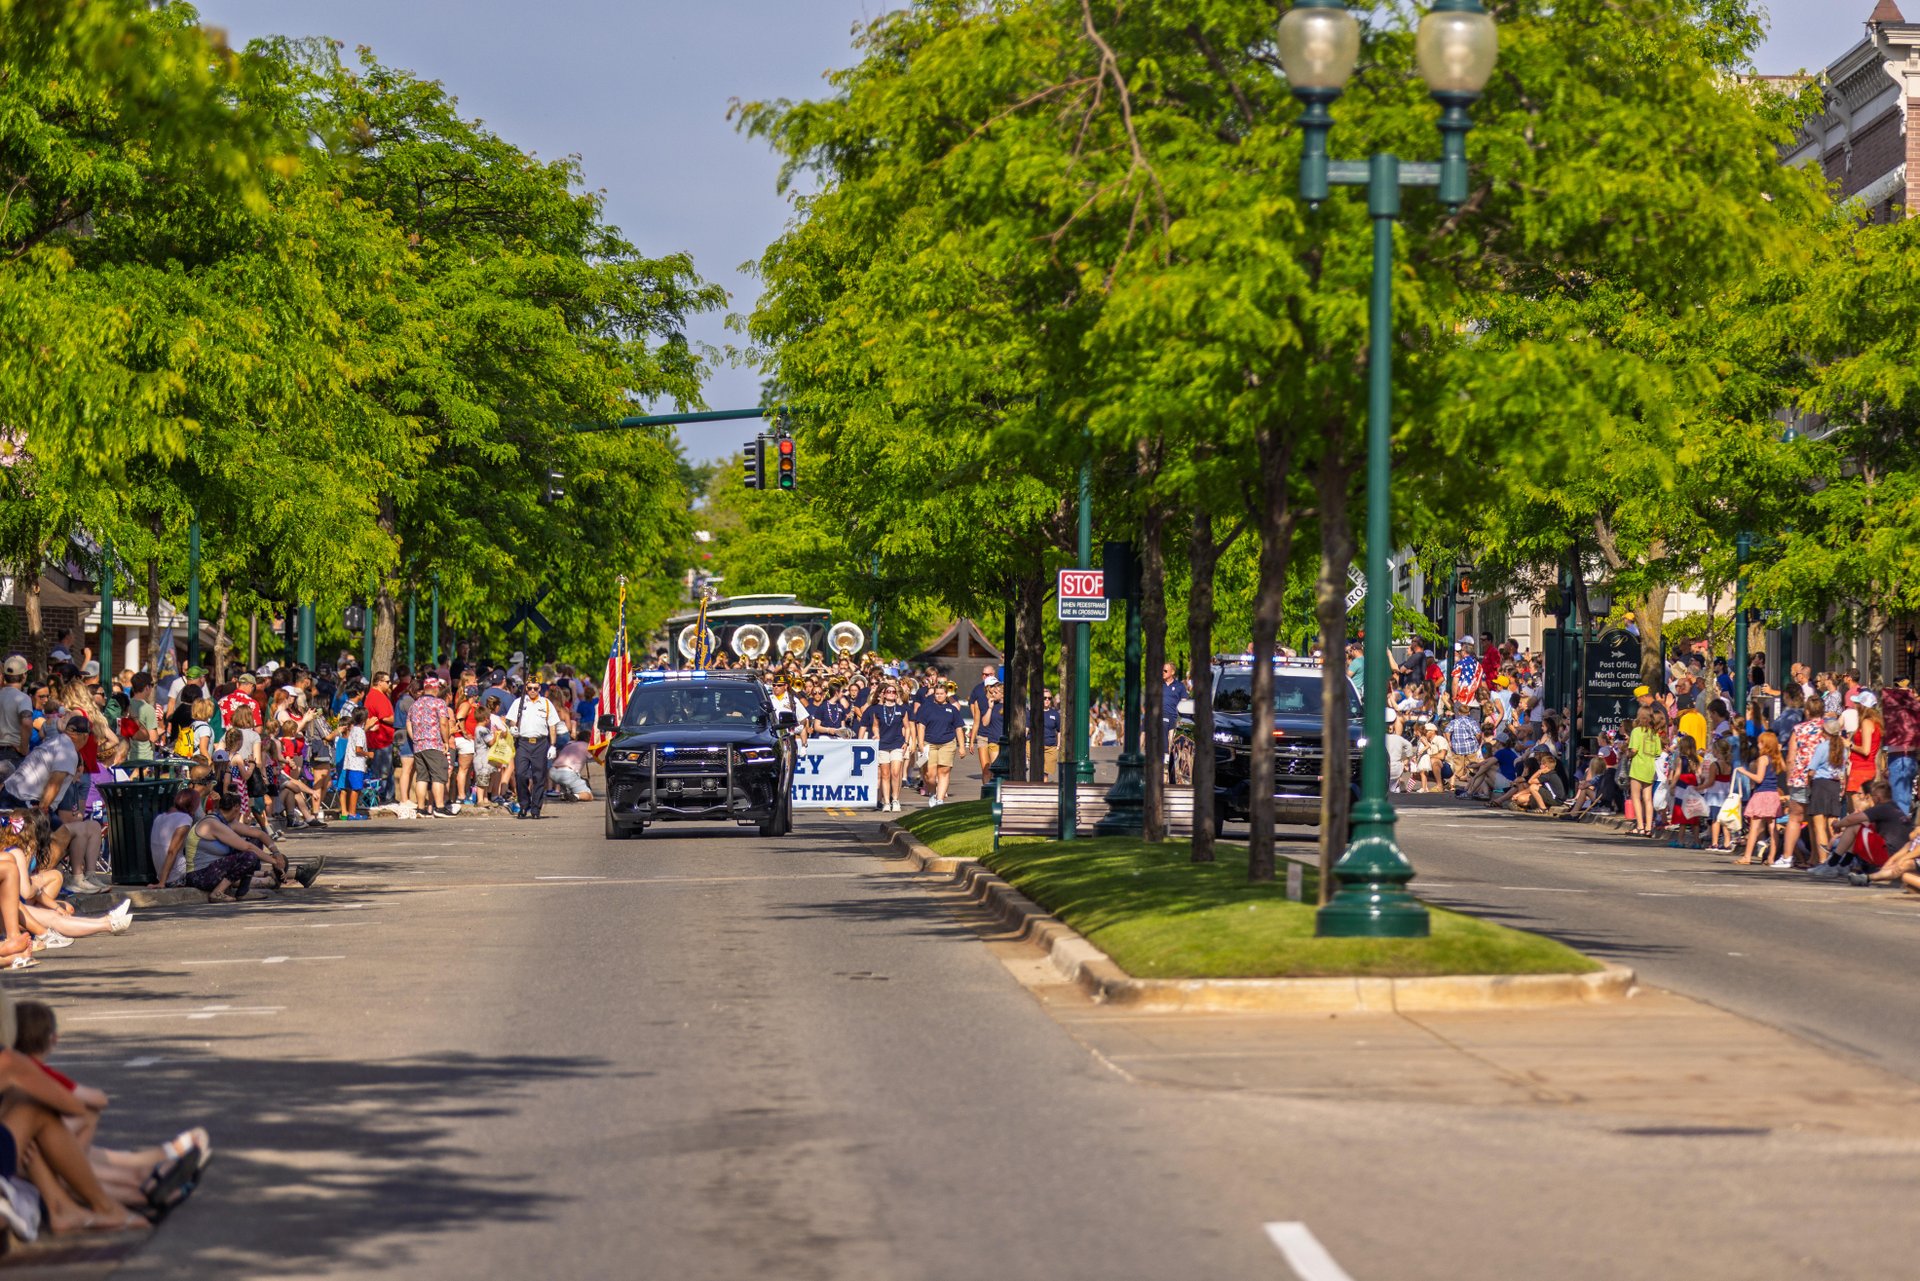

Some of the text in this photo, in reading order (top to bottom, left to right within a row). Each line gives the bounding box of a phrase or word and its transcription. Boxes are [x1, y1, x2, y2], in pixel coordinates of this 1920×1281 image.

[1064, 575, 1104, 595] STOP
[1616, 661, 1637, 669] Office
[1588, 680, 1620, 689] Michigan
[851, 746, 875, 776] P
